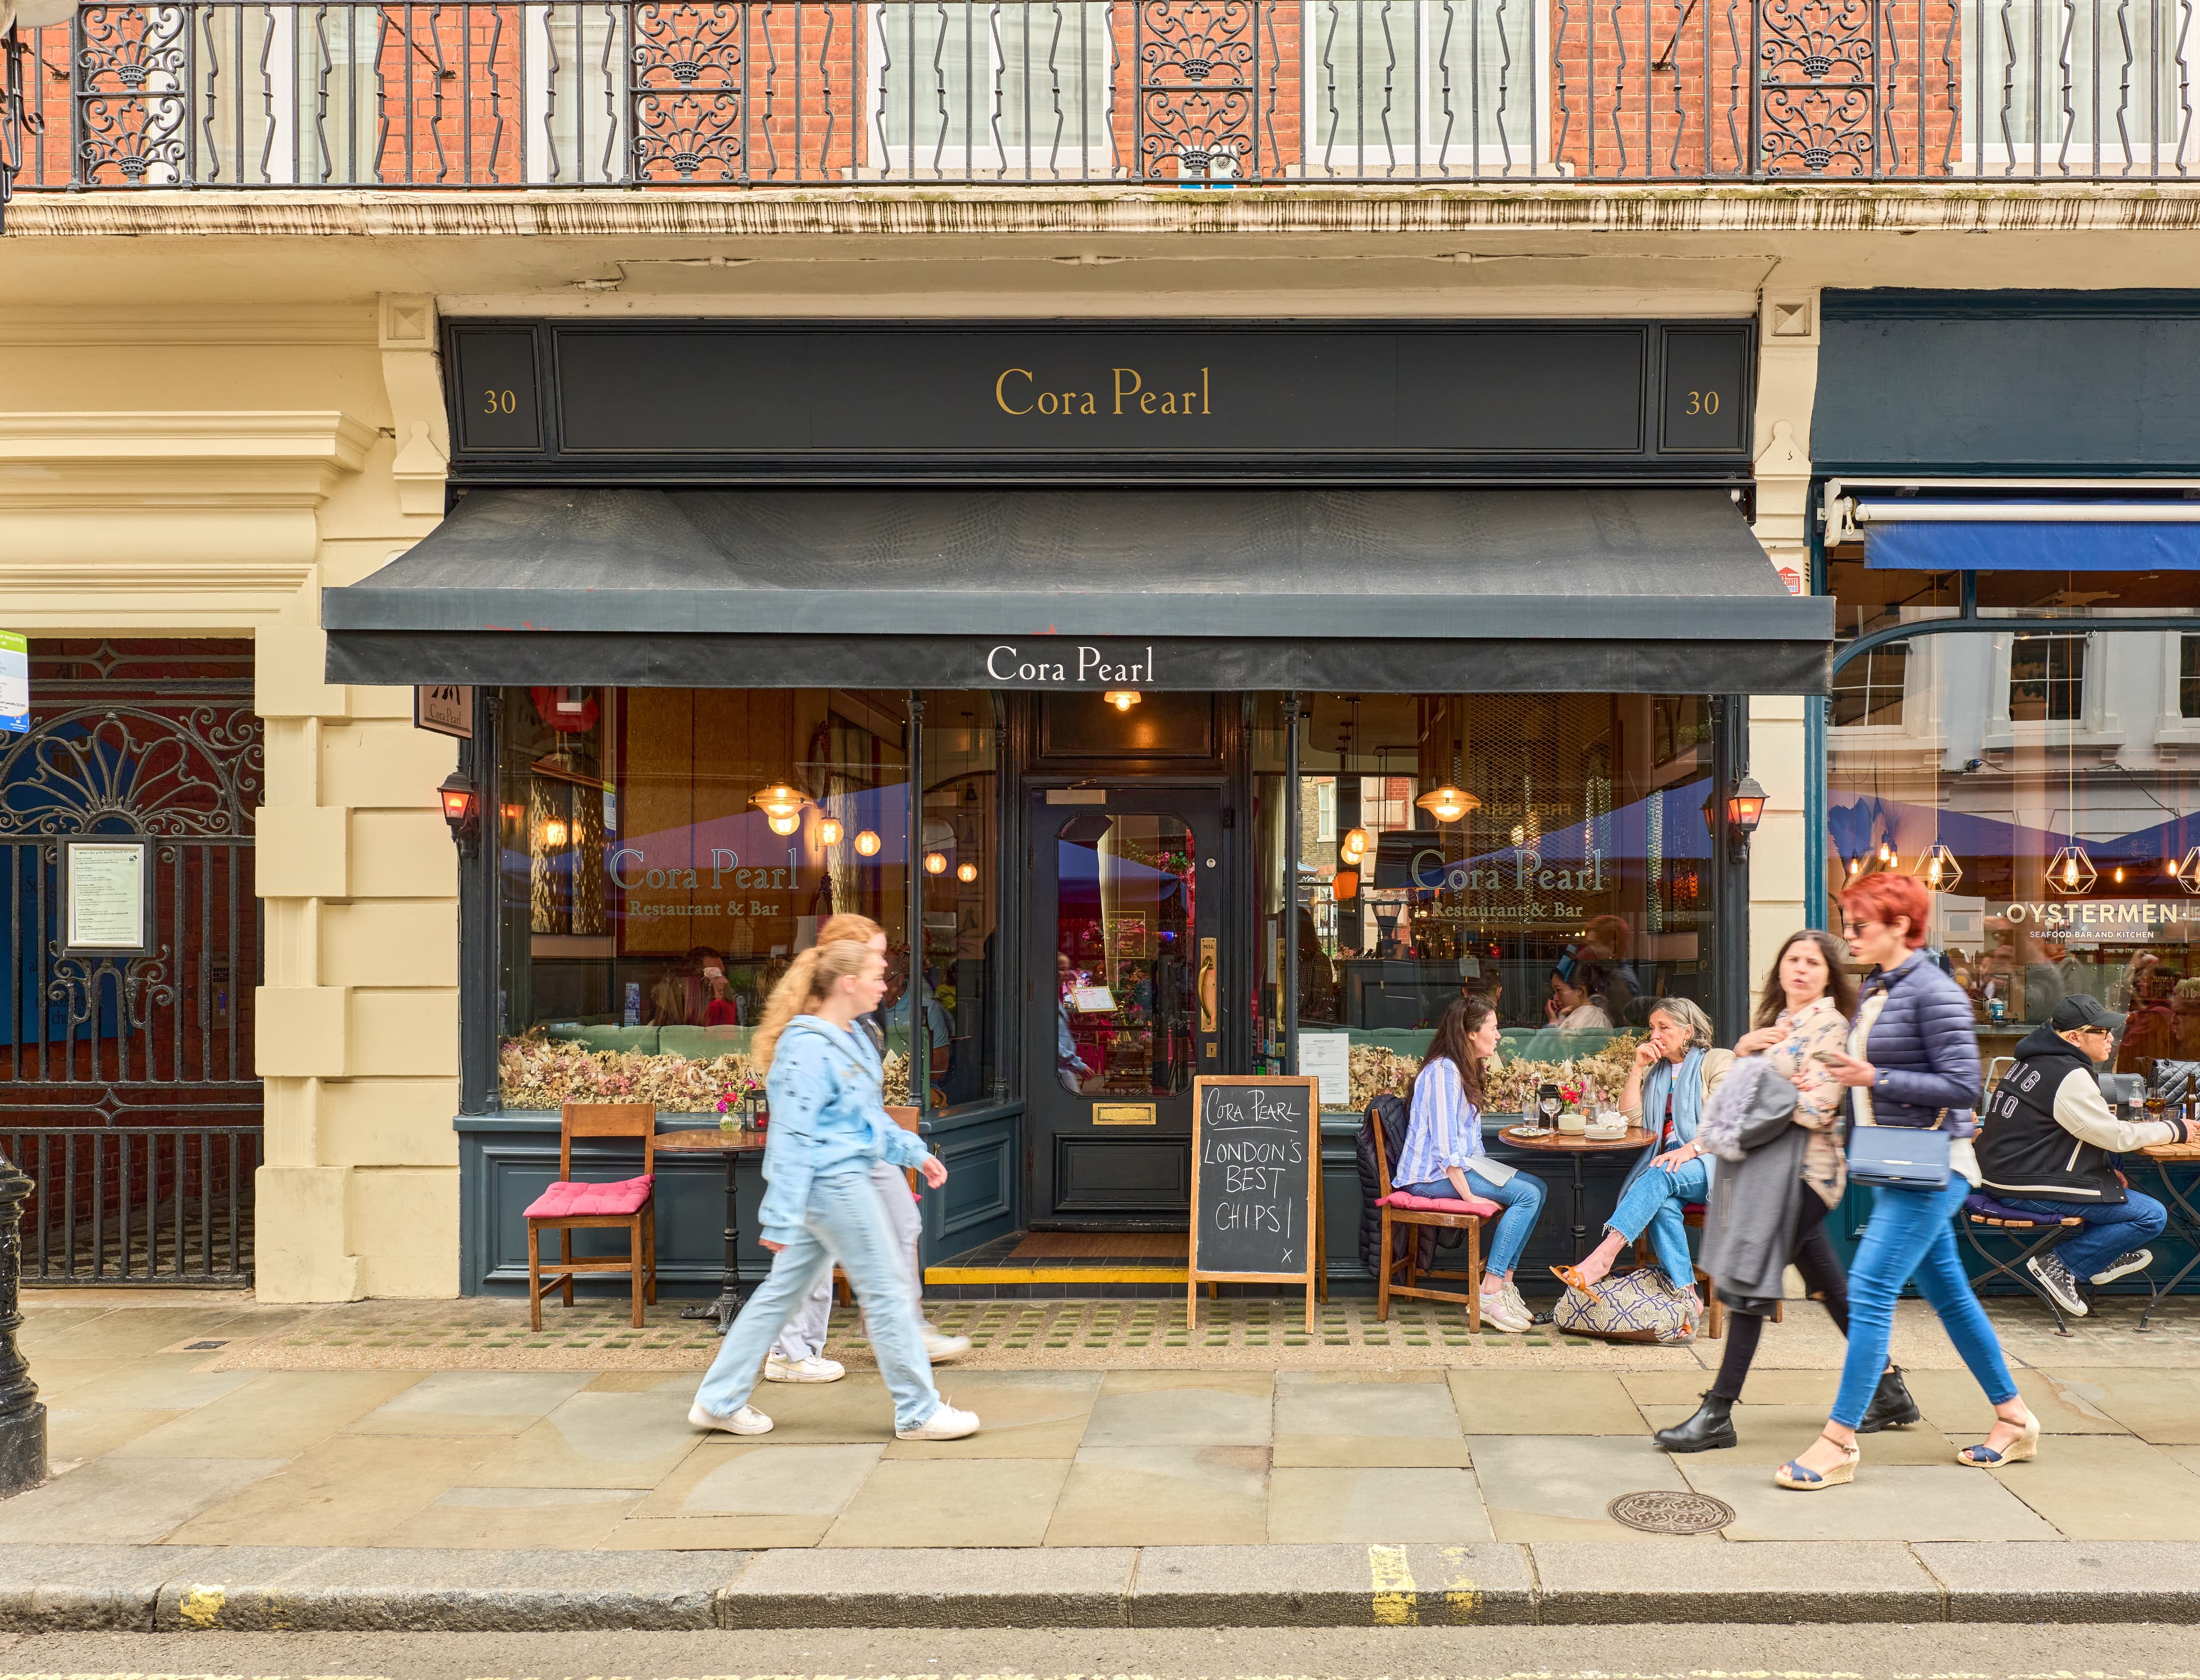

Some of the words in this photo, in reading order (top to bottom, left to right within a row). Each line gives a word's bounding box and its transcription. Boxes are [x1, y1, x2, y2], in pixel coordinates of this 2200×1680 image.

[484, 390, 516, 413] 30
[996, 368, 1097, 415] Cora
[1111, 367, 1212, 414] Pearl
[1686, 391, 1719, 414] 30
[987, 646, 1066, 680] Cora
[1077, 646, 1154, 681] Pearl
[430, 703, 445, 721] Cora
[446, 707, 461, 725] Pearl
[610, 848, 699, 889] Cora
[711, 847, 799, 889] Pearl
[1411, 849, 1502, 890] Cora
[1514, 849, 1604, 890] Pearl
[630, 901, 721, 916] Restaurant
[727, 900, 744, 916] &
[750, 901, 779, 916] Bar
[1432, 902, 1528, 917] Restaurant
[1530, 902, 1547, 917] &
[1553, 902, 1584, 917] Bar
[2006, 904, 2177, 923] OYSTERMEN
[1206, 1088, 1244, 1125] CORA
[1246, 1089, 1301, 1122] PEARL
[1204, 1139, 1302, 1164] LONDON'S
[1226, 1165, 1286, 1199] BEST
[1216, 1196, 1291, 1238] CHIPS!
